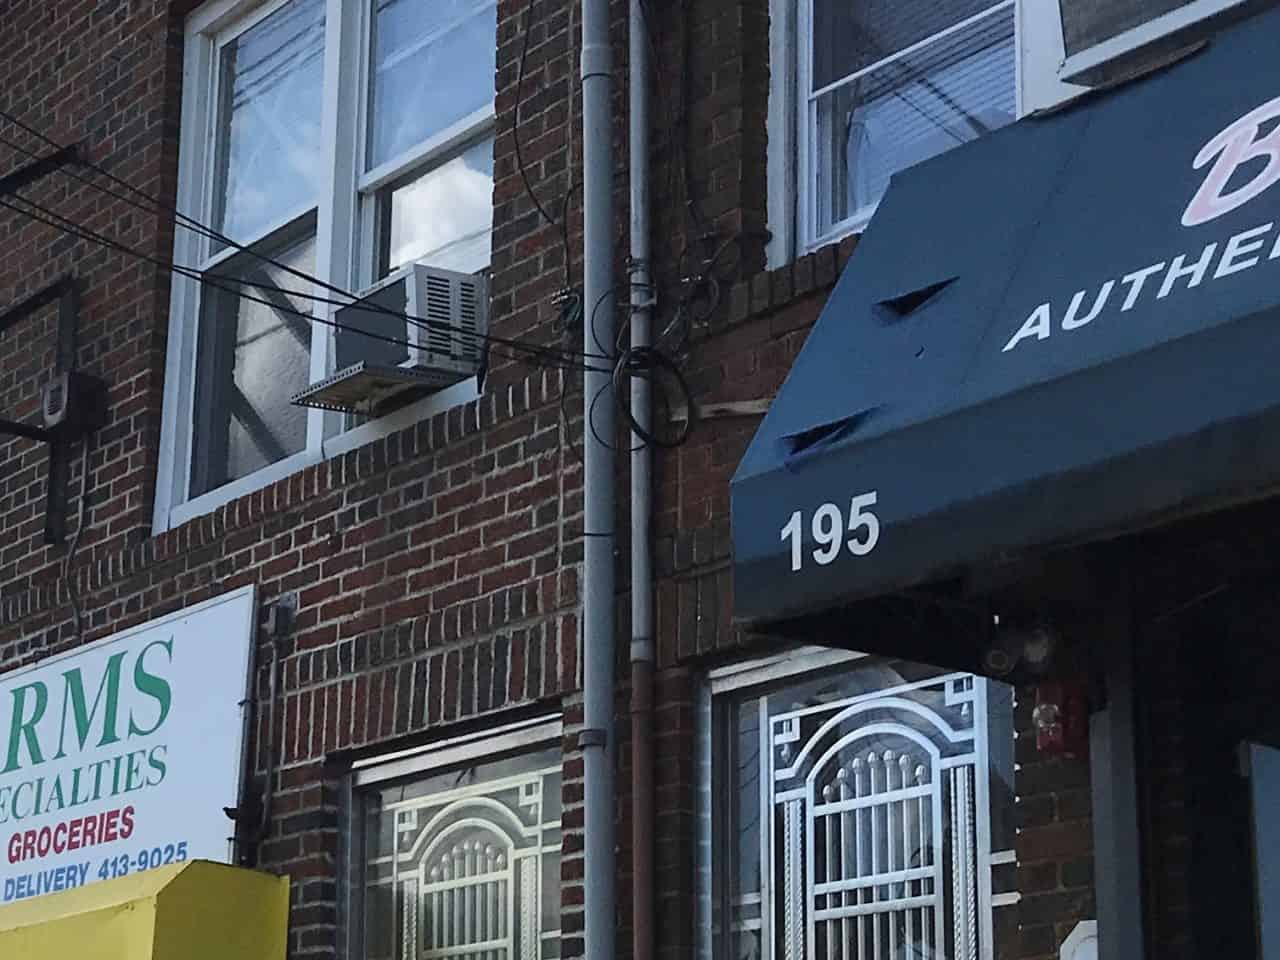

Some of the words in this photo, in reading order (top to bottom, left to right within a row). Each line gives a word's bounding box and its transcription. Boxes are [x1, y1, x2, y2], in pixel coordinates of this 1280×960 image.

[1001, 222, 1280, 353] AUTHE
[780, 491, 880, 571] 195
[8, 805, 135, 864] GROCERIES
[4, 861, 90, 901] DELIVERY
[98, 841, 188, 881] 413-9025
